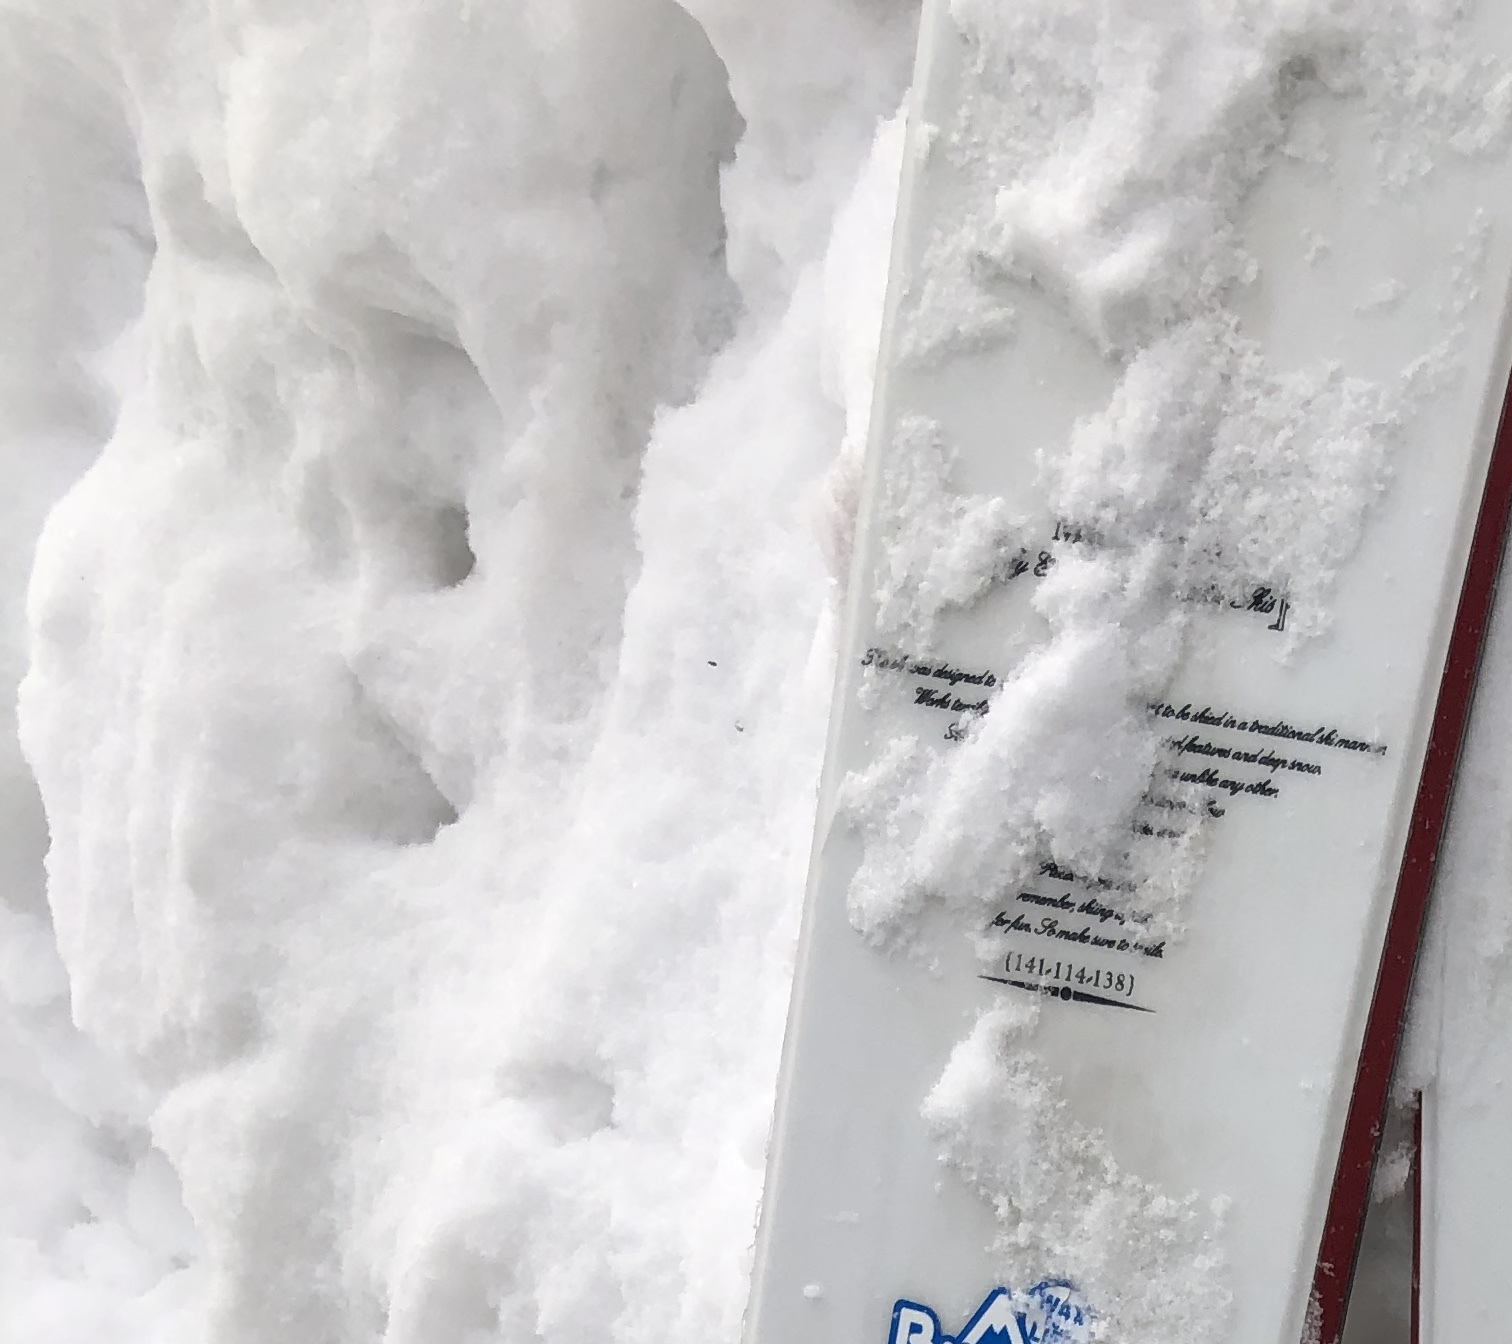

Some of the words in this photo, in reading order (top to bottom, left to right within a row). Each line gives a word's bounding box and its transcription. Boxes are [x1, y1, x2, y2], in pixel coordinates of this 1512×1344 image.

[932, 663, 990, 687] designed
[1249, 720, 1326, 744] traditional
[1231, 748, 1265, 768] and
[1258, 750, 1289, 774] deep
[1218, 778, 1247, 797] any
[1055, 926, 1092, 945] make
